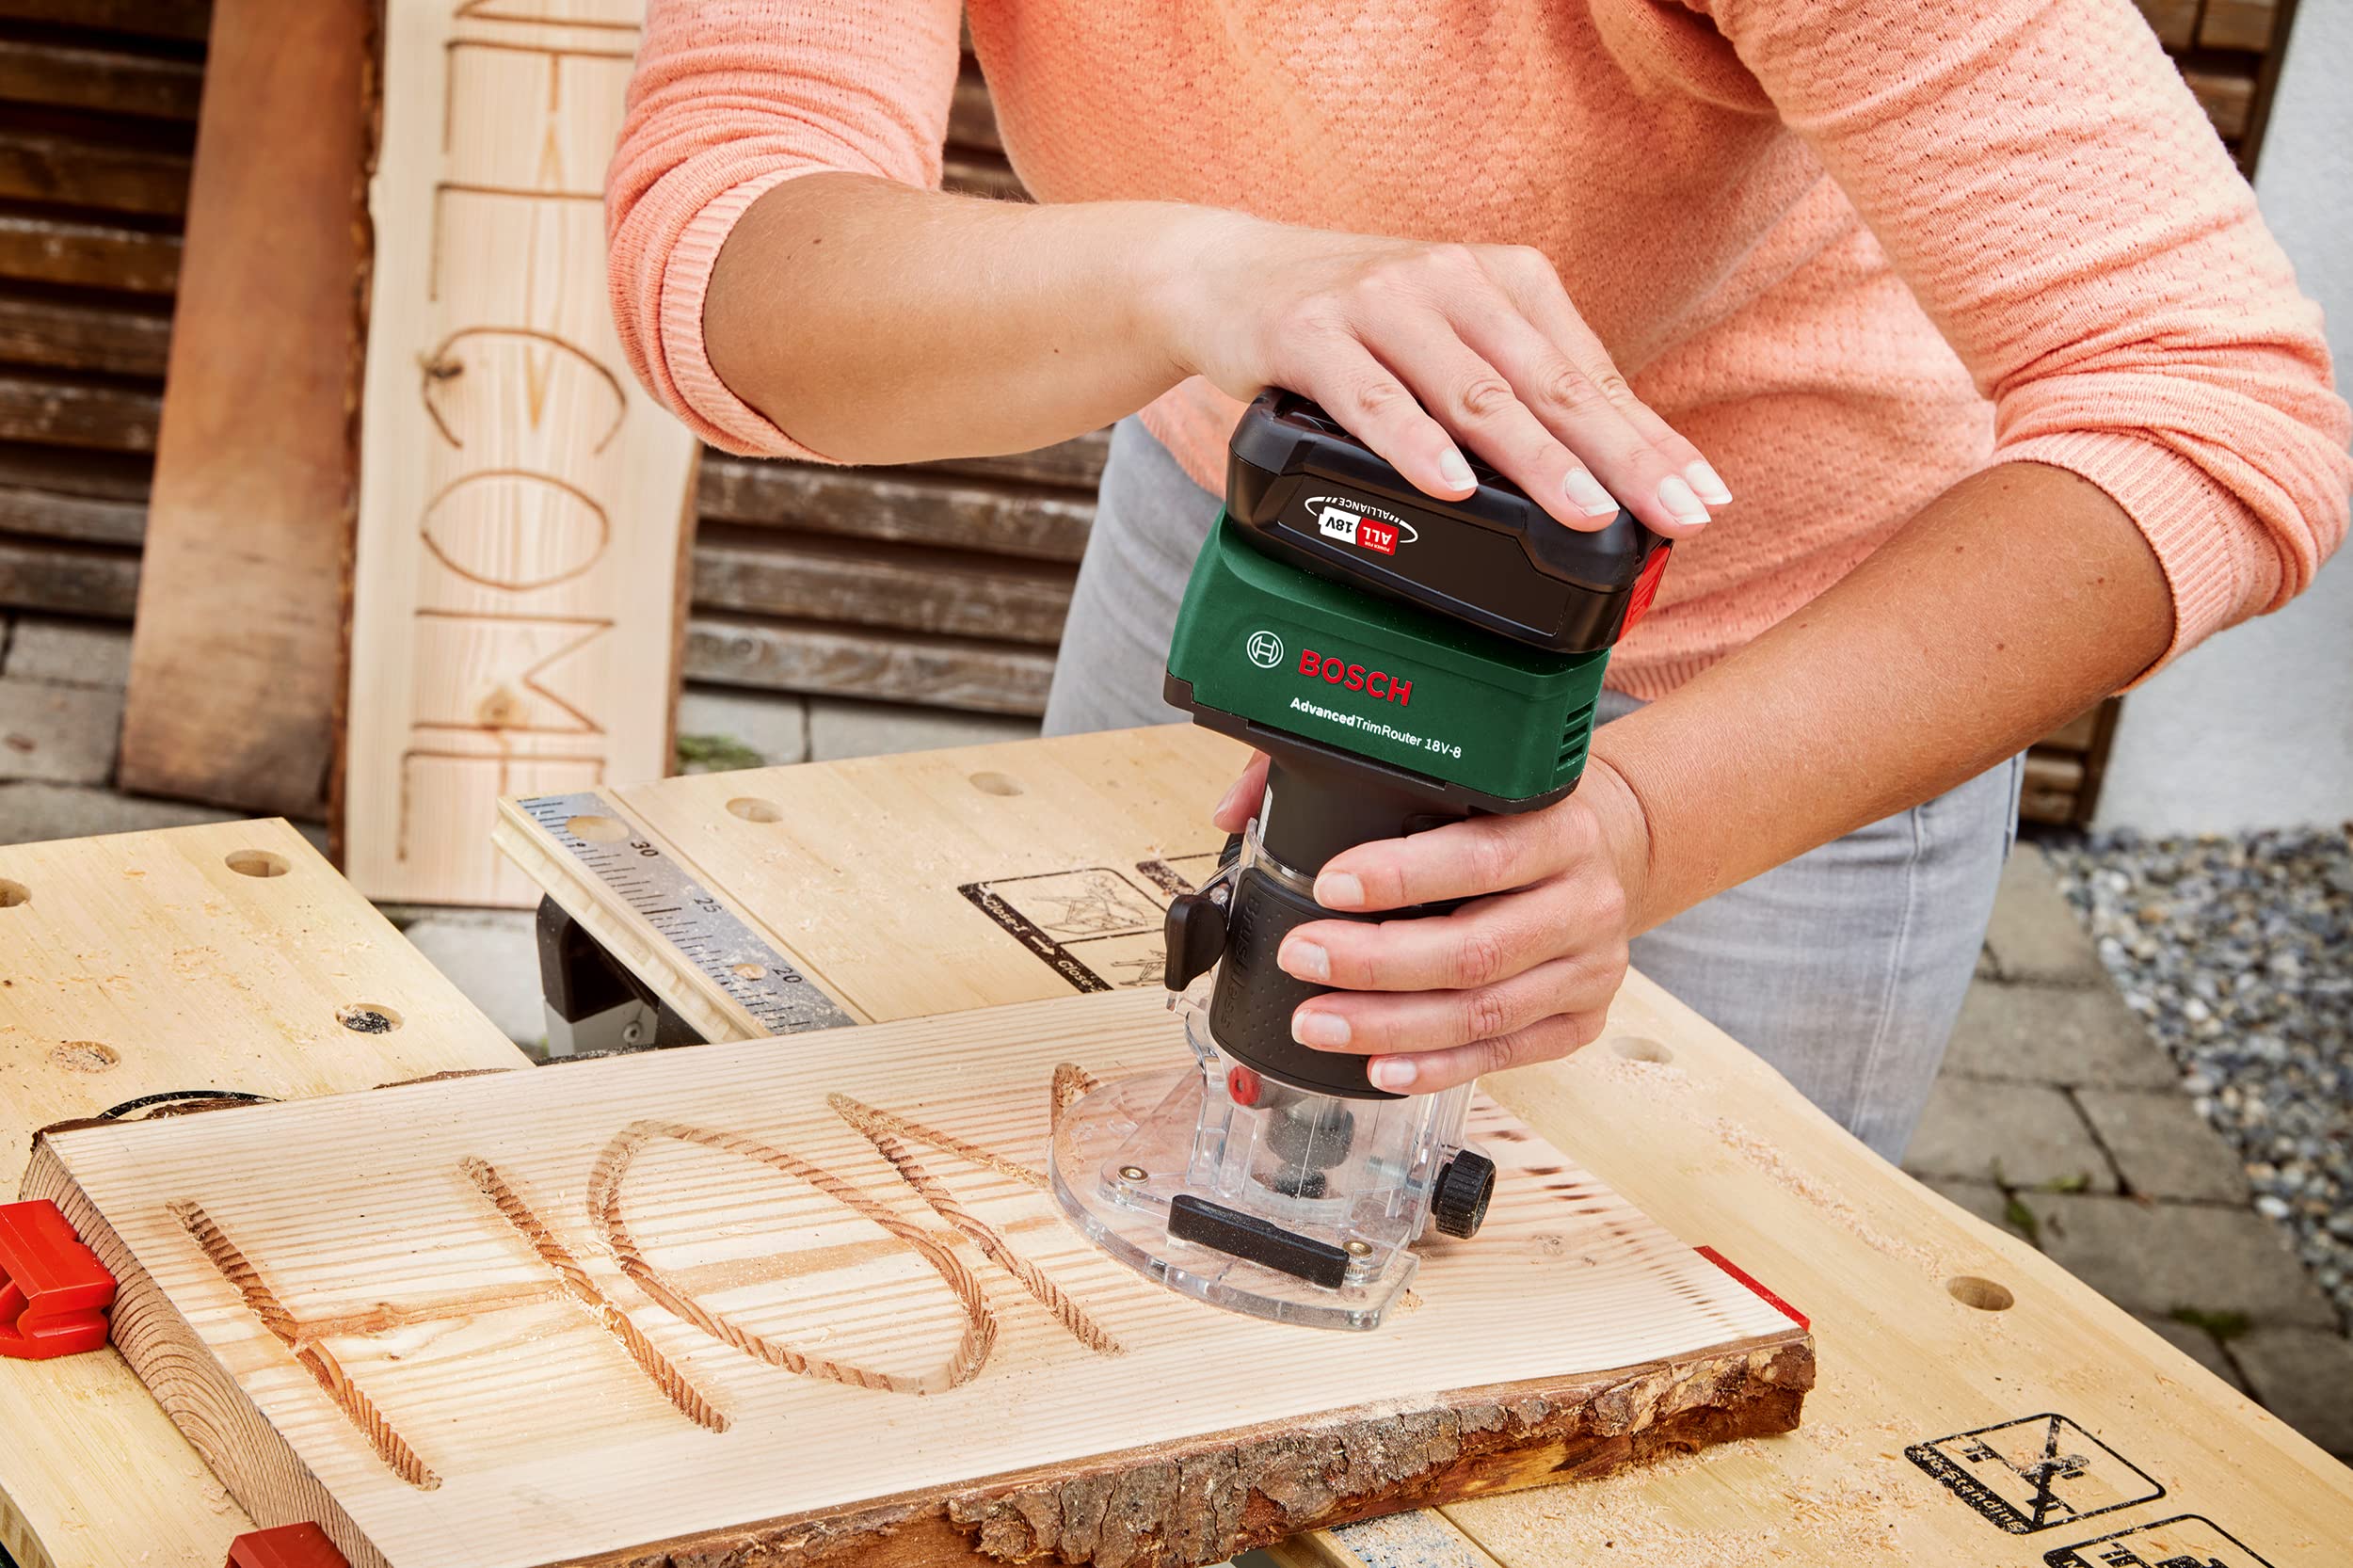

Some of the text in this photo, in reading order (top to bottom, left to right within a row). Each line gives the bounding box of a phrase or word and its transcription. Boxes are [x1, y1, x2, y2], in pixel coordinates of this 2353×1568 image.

[1339, 497, 1390, 520] ALLIANCE
[1325, 516, 1353, 534] 18V
[1363, 526, 1393, 545] ALL
[1298, 648, 1413, 707] BOSCH
[1289, 697, 1462, 760] AdvancedTrimRouter 18V-8
[630, 841, 659, 857] 30
[693, 897, 723, 914] 25
[1220, 896, 1261, 1029] Brushless
[772, 967, 803, 984] 20
